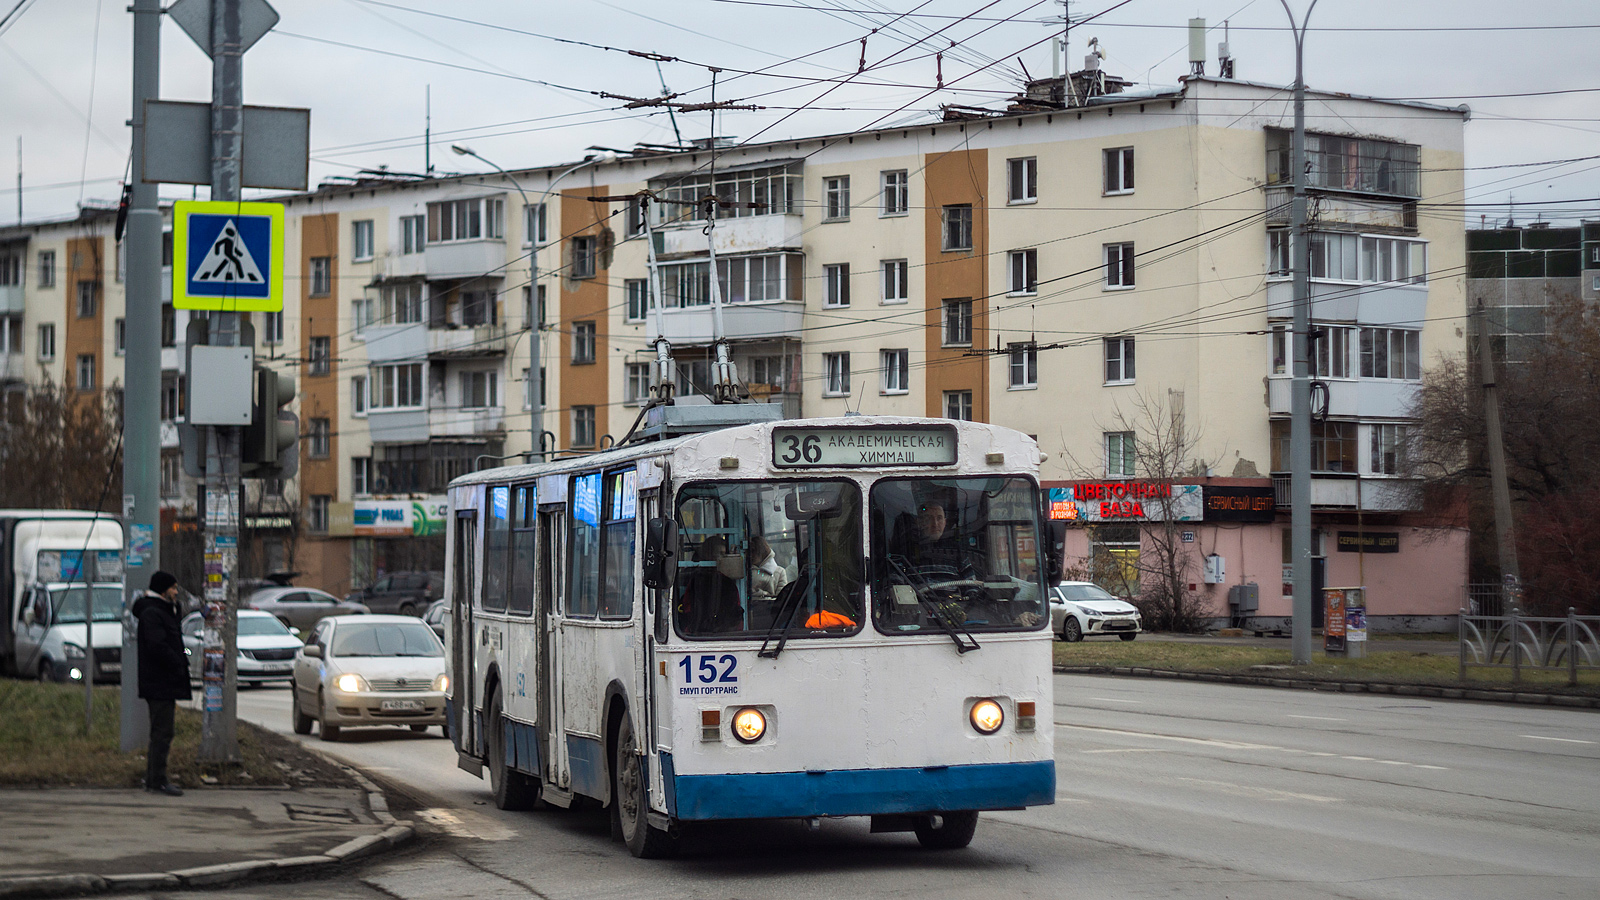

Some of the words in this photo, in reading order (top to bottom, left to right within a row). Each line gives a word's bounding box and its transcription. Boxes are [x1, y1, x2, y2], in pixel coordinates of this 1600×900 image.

[781, 434, 822, 464] 36
[828, 435, 944, 448] АКАДЕМИЧЕСКАЯ
[859, 451, 915, 464] ХИММАШ
[1100, 501, 1145, 518] БАЗА
[1209, 495, 1250, 511] СЕРВИСНЫЙ
[1252, 496, 1273, 511] ЦЕНТР
[1339, 536, 1375, 546] СЕРВИНЫЙ
[679, 654, 738, 683] 152
[679, 687, 700, 695] ЕМУП
[700, 686, 738, 695] ГОРТРАНС
